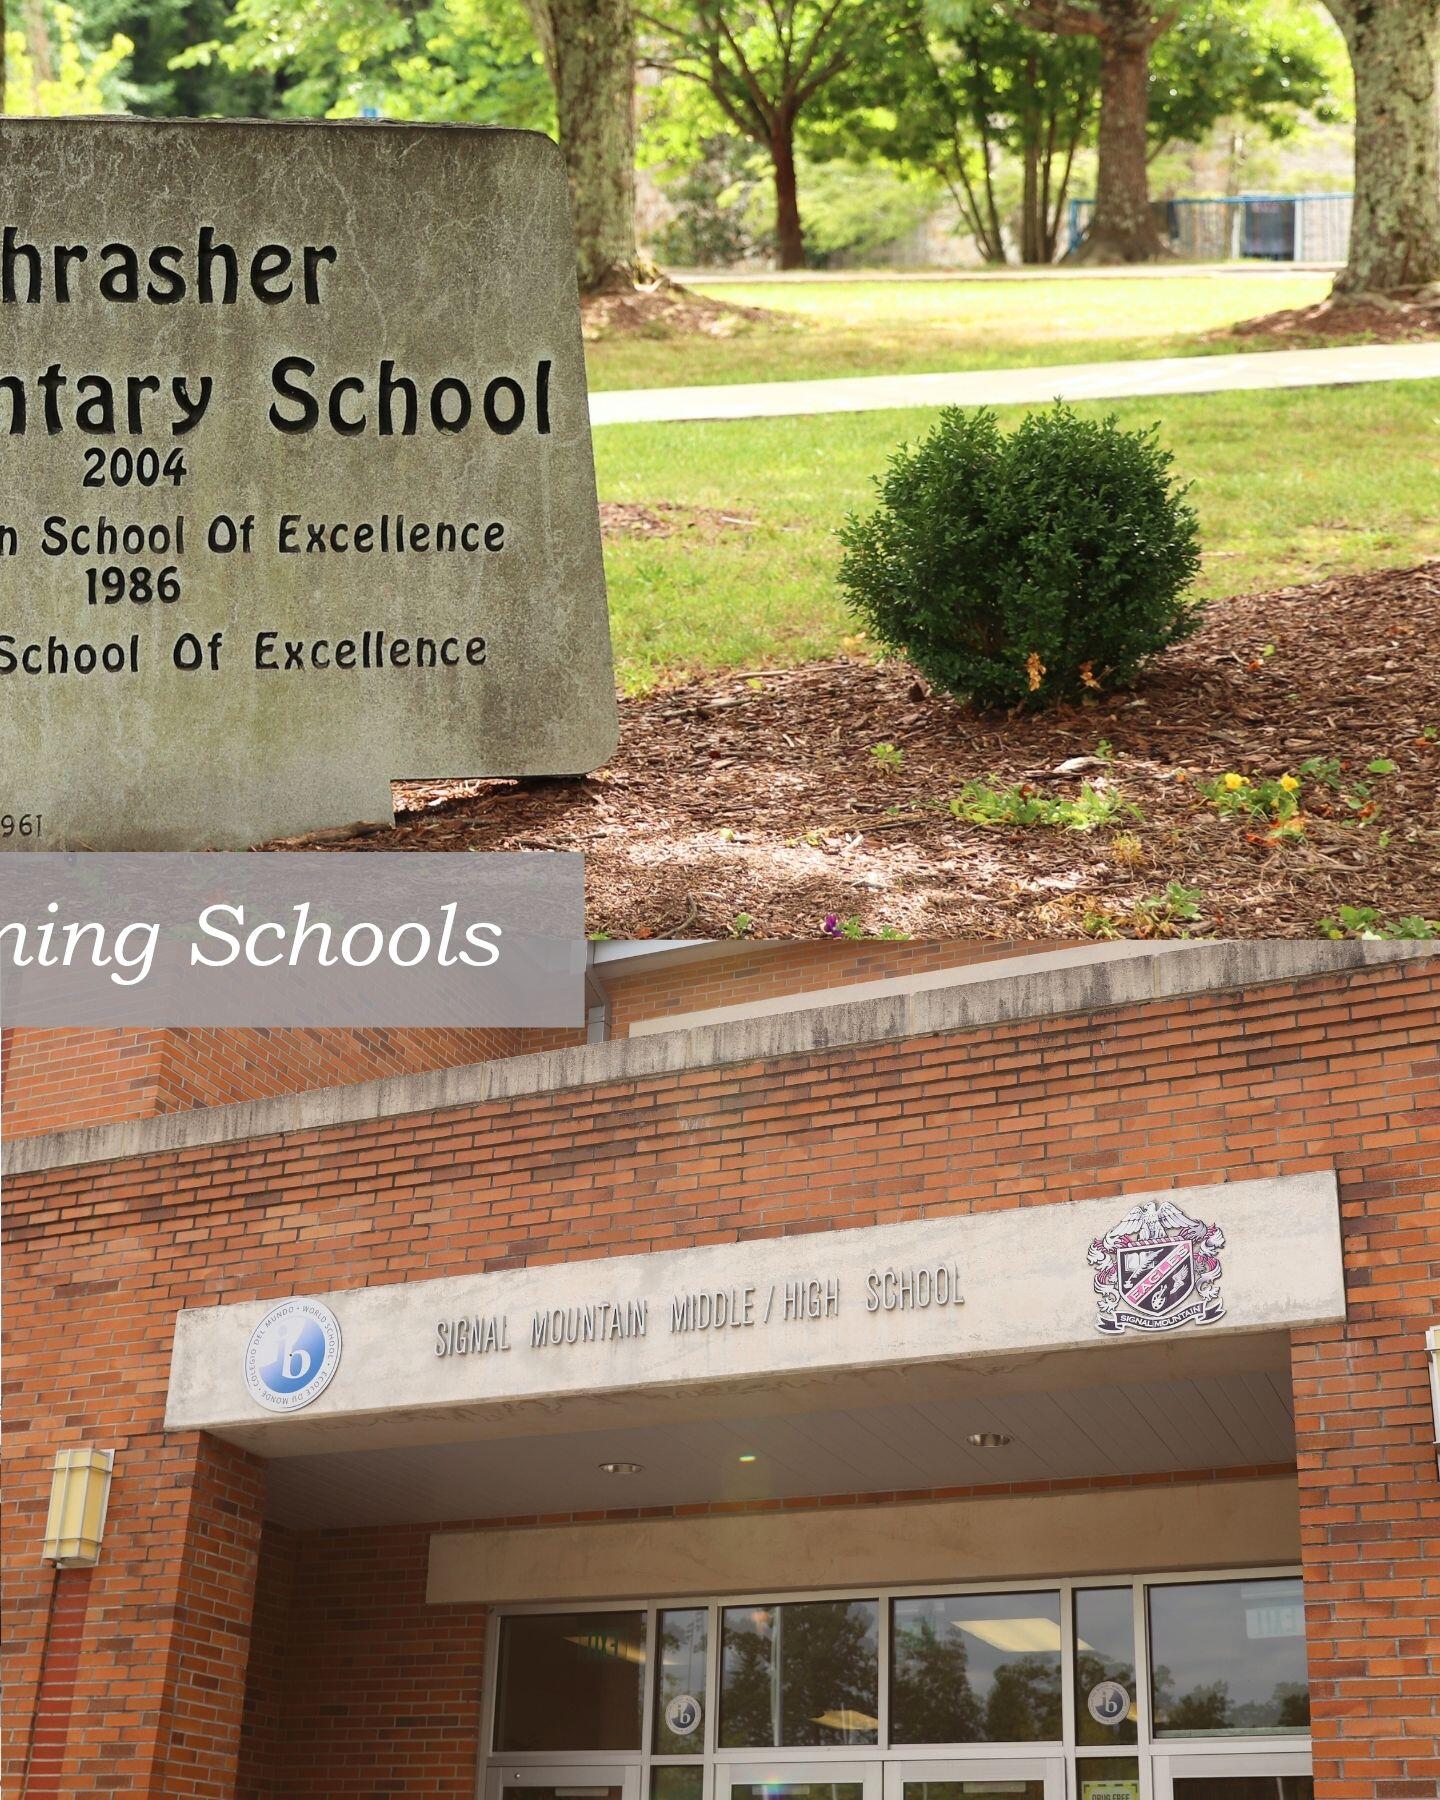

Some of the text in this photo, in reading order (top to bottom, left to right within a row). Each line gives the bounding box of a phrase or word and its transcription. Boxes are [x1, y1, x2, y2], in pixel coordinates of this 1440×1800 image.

[269, 356, 552, 437] School
[82, 447, 187, 488] 2004
[41, 515, 185, 556] School
[207, 514, 255, 554] Of
[278, 514, 505, 554] Excellence
[85, 565, 182, 605] 1986
[173, 632, 223, 671] Of
[255, 630, 487, 670] Excellence
[302, 1305, 336, 1359] WORLD SCHOOL
[434, 1314, 511, 1358] SIGNAL
[529, 1297, 648, 1348] MOUNTAIN
[864, 1265, 965, 1313] SCHOOL
[1120, 1305, 1201, 1328] SIGNAL MOUNTAIN
[249, 1307, 293, 1388] COLEGIO DEL MUNDO
[261, 1391, 289, 1405] MONDE
[291, 1393, 304, 1403] DU
